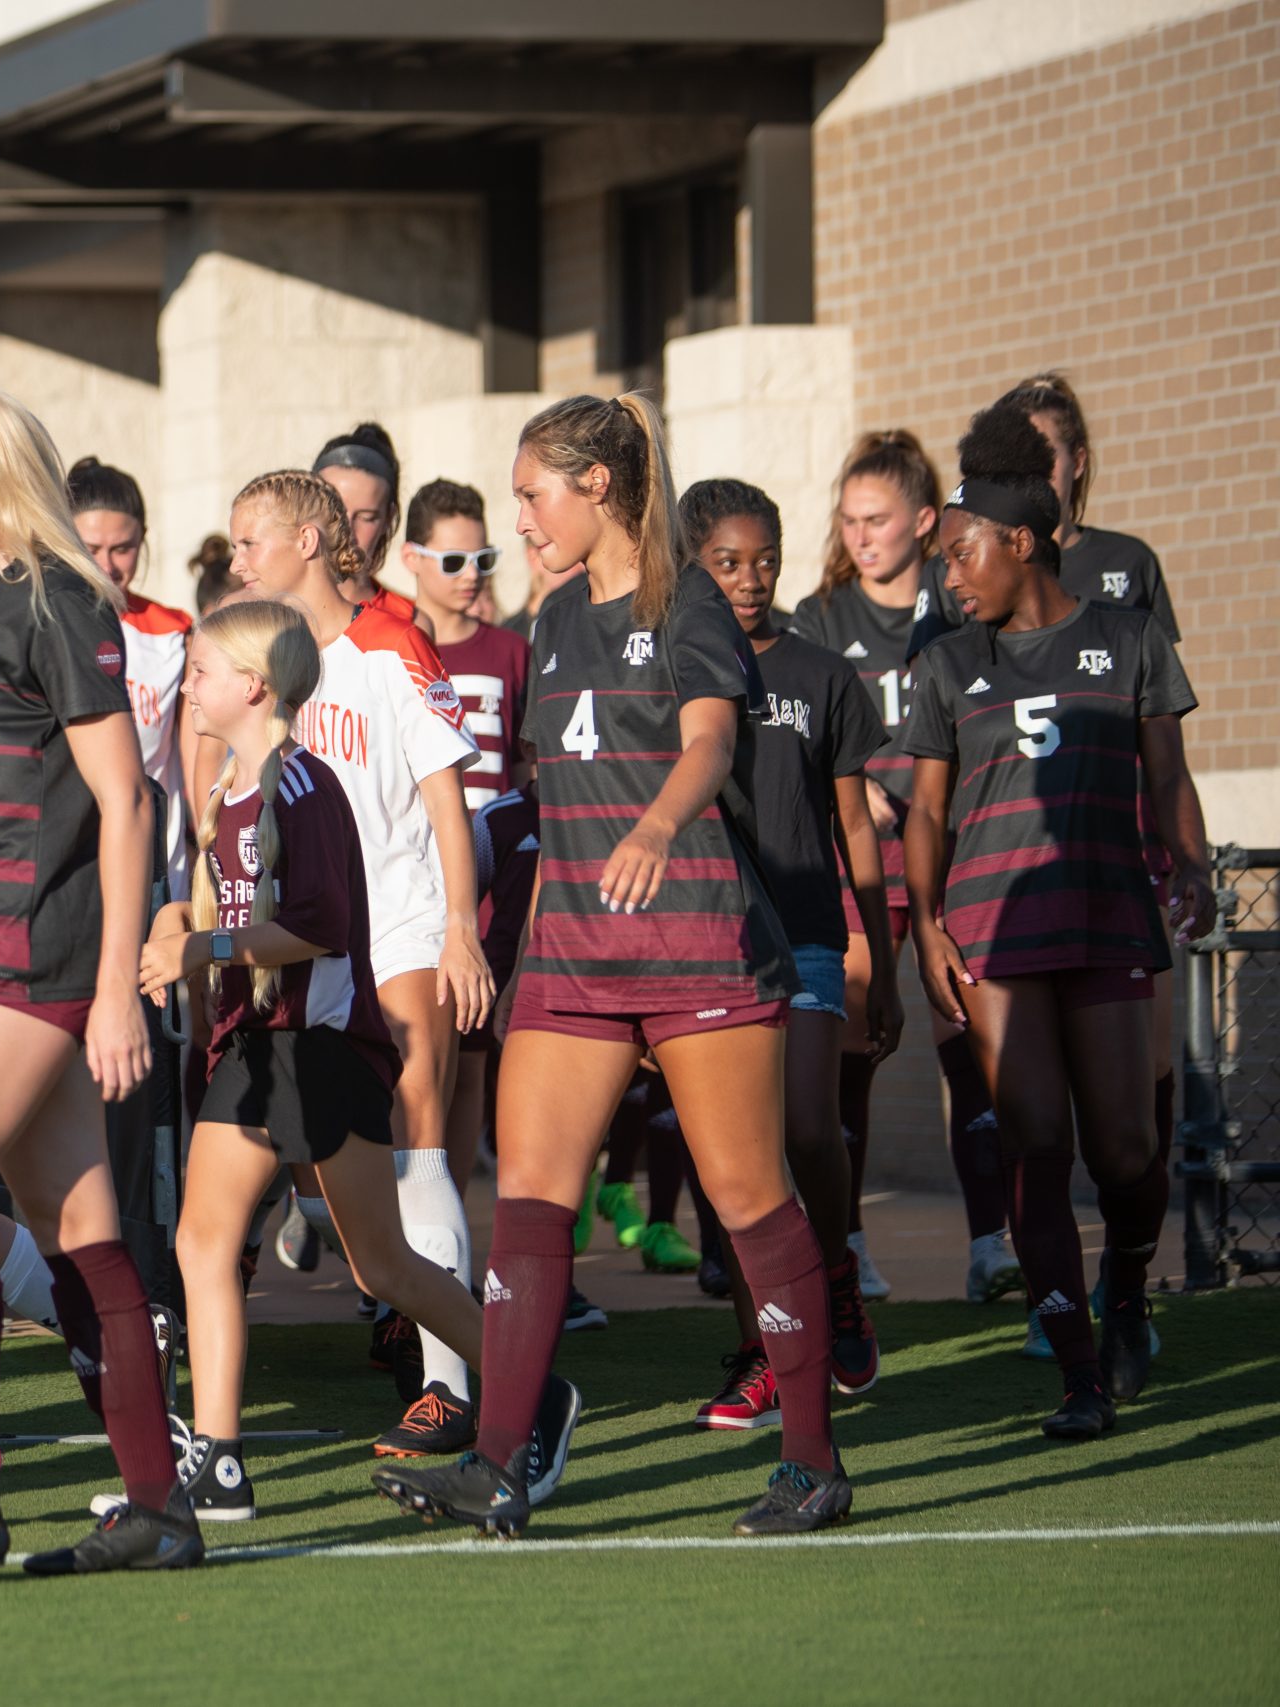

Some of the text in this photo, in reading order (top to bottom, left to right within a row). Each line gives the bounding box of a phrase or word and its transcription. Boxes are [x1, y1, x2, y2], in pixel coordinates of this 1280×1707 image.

[561, 689, 599, 761] 4
[761, 693, 811, 738] A&M
[1014, 694, 1061, 759] 5
[696, 1008, 727, 1019] adidas
